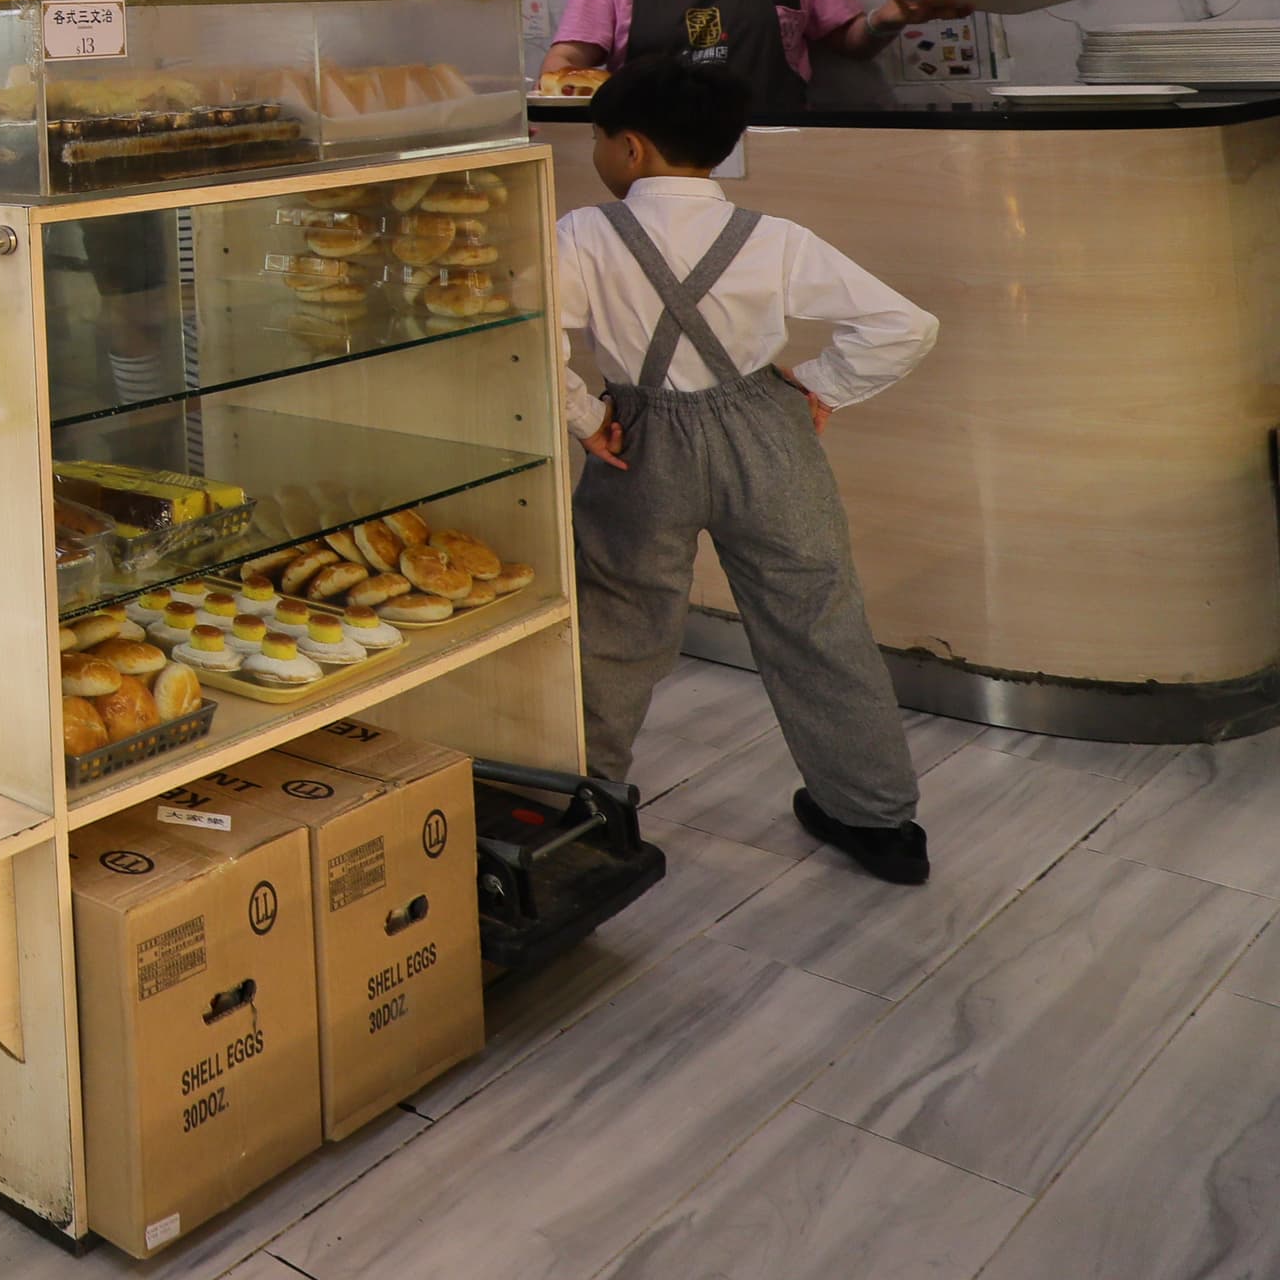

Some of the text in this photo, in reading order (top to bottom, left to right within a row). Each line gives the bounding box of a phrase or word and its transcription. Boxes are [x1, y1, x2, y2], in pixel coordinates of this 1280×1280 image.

[53, 9, 113, 25] 各式三文治
[76, 37, 95, 55] $13
[368, 942, 437, 1001] SHELL EGGS
[181, 1029, 264, 1096] SHELL EGGS
[183, 1086, 229, 1133] 30DOZ.
